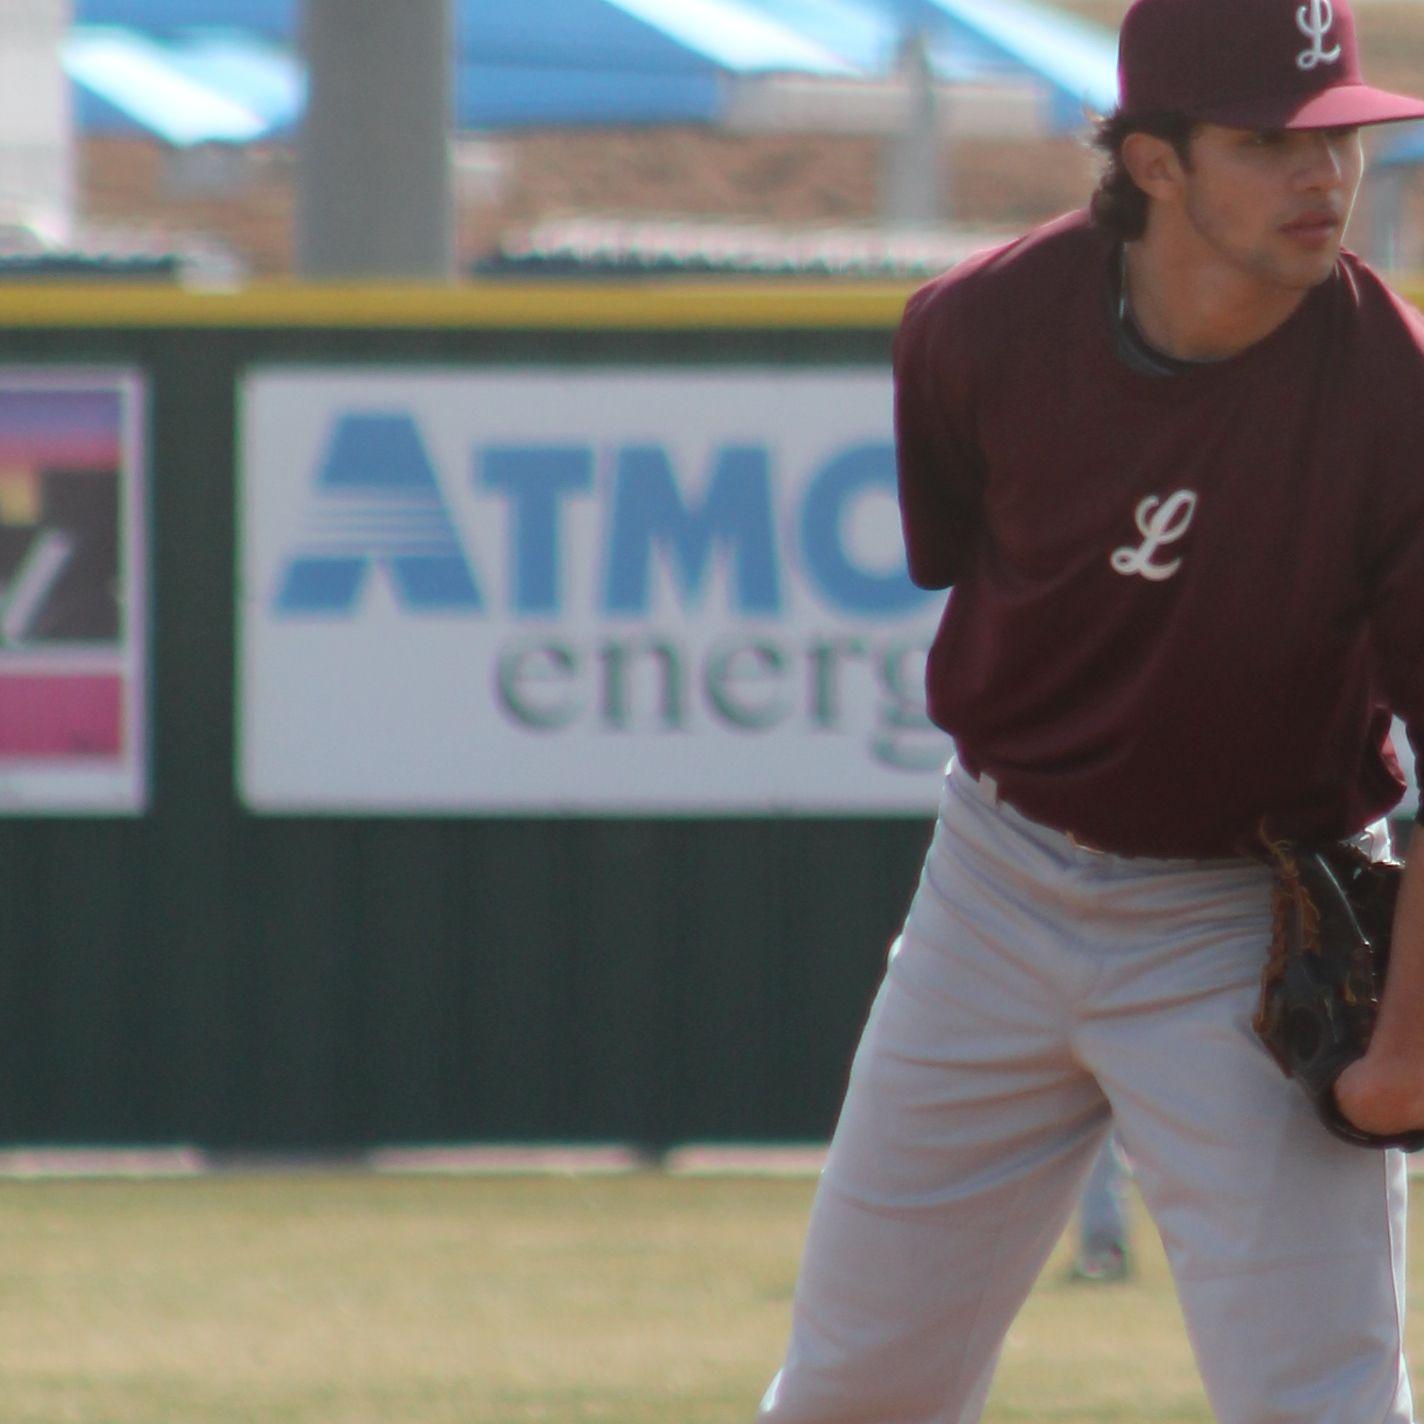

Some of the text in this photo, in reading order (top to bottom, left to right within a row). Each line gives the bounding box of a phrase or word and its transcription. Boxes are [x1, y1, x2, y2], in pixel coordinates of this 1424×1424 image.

[272, 412, 950, 618] ATMO
[1112, 489, 1197, 581] L
[494, 631, 948, 772] energ
